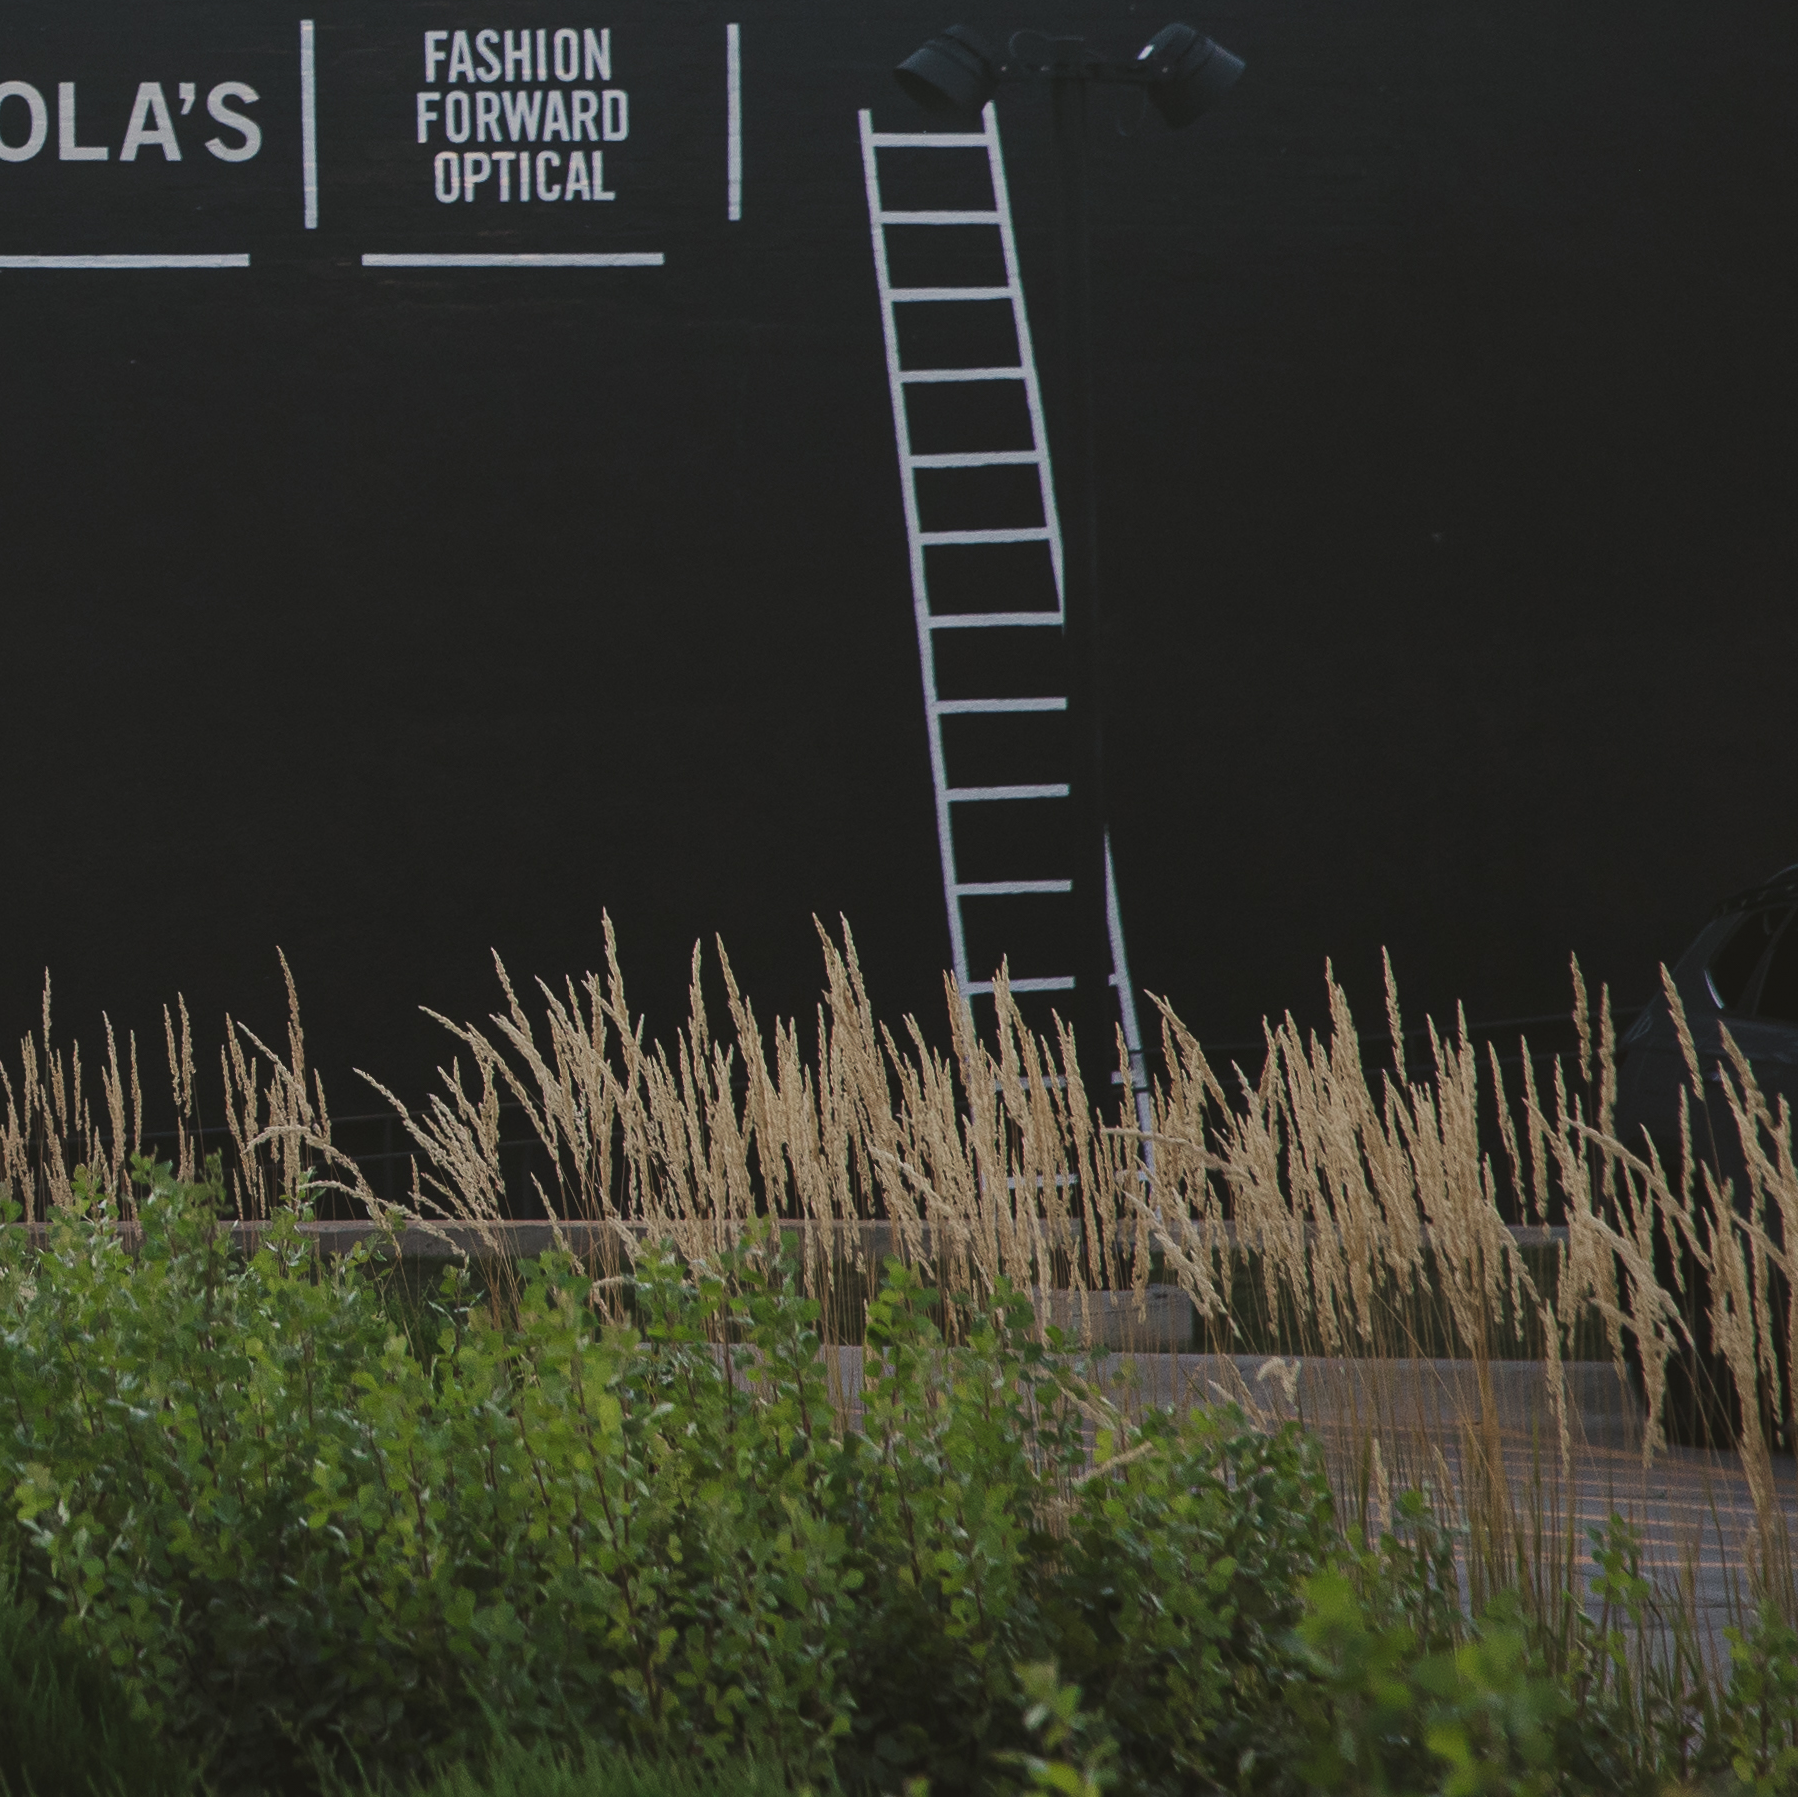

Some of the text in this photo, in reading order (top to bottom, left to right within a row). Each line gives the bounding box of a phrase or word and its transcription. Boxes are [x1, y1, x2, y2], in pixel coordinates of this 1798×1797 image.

[423, 27, 612, 84] FASHION
[416, 89, 629, 144] FORWARD
[433, 150, 617, 204] OPTICAL
